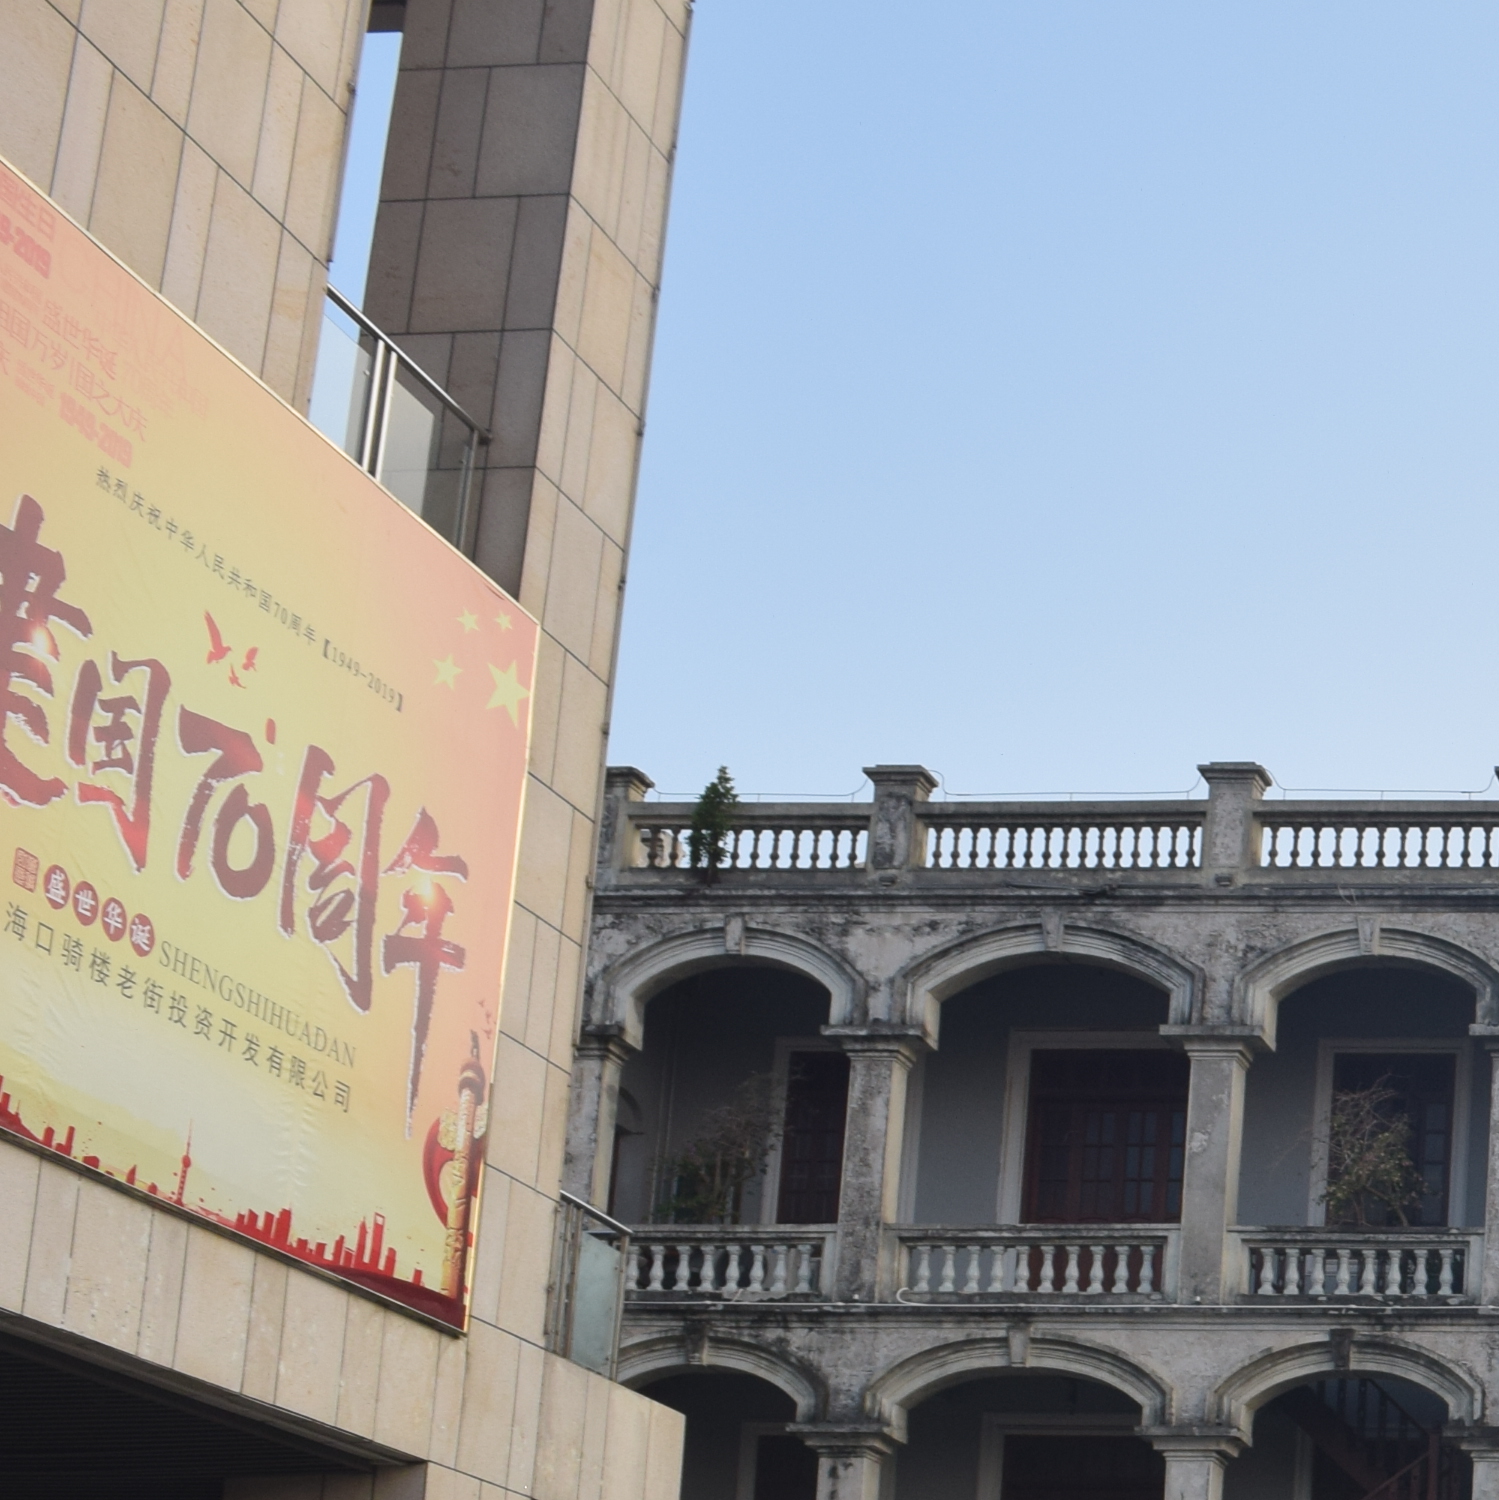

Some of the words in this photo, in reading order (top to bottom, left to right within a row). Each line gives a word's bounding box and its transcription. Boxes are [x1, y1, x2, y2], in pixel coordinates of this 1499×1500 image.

[4, 901, 352, 1114] 海口骑楼老街投资开发有限公司
[45, 867, 153, 954] 盛世华诞
[159, 940, 357, 1068] SHENGSHIHUADAN
